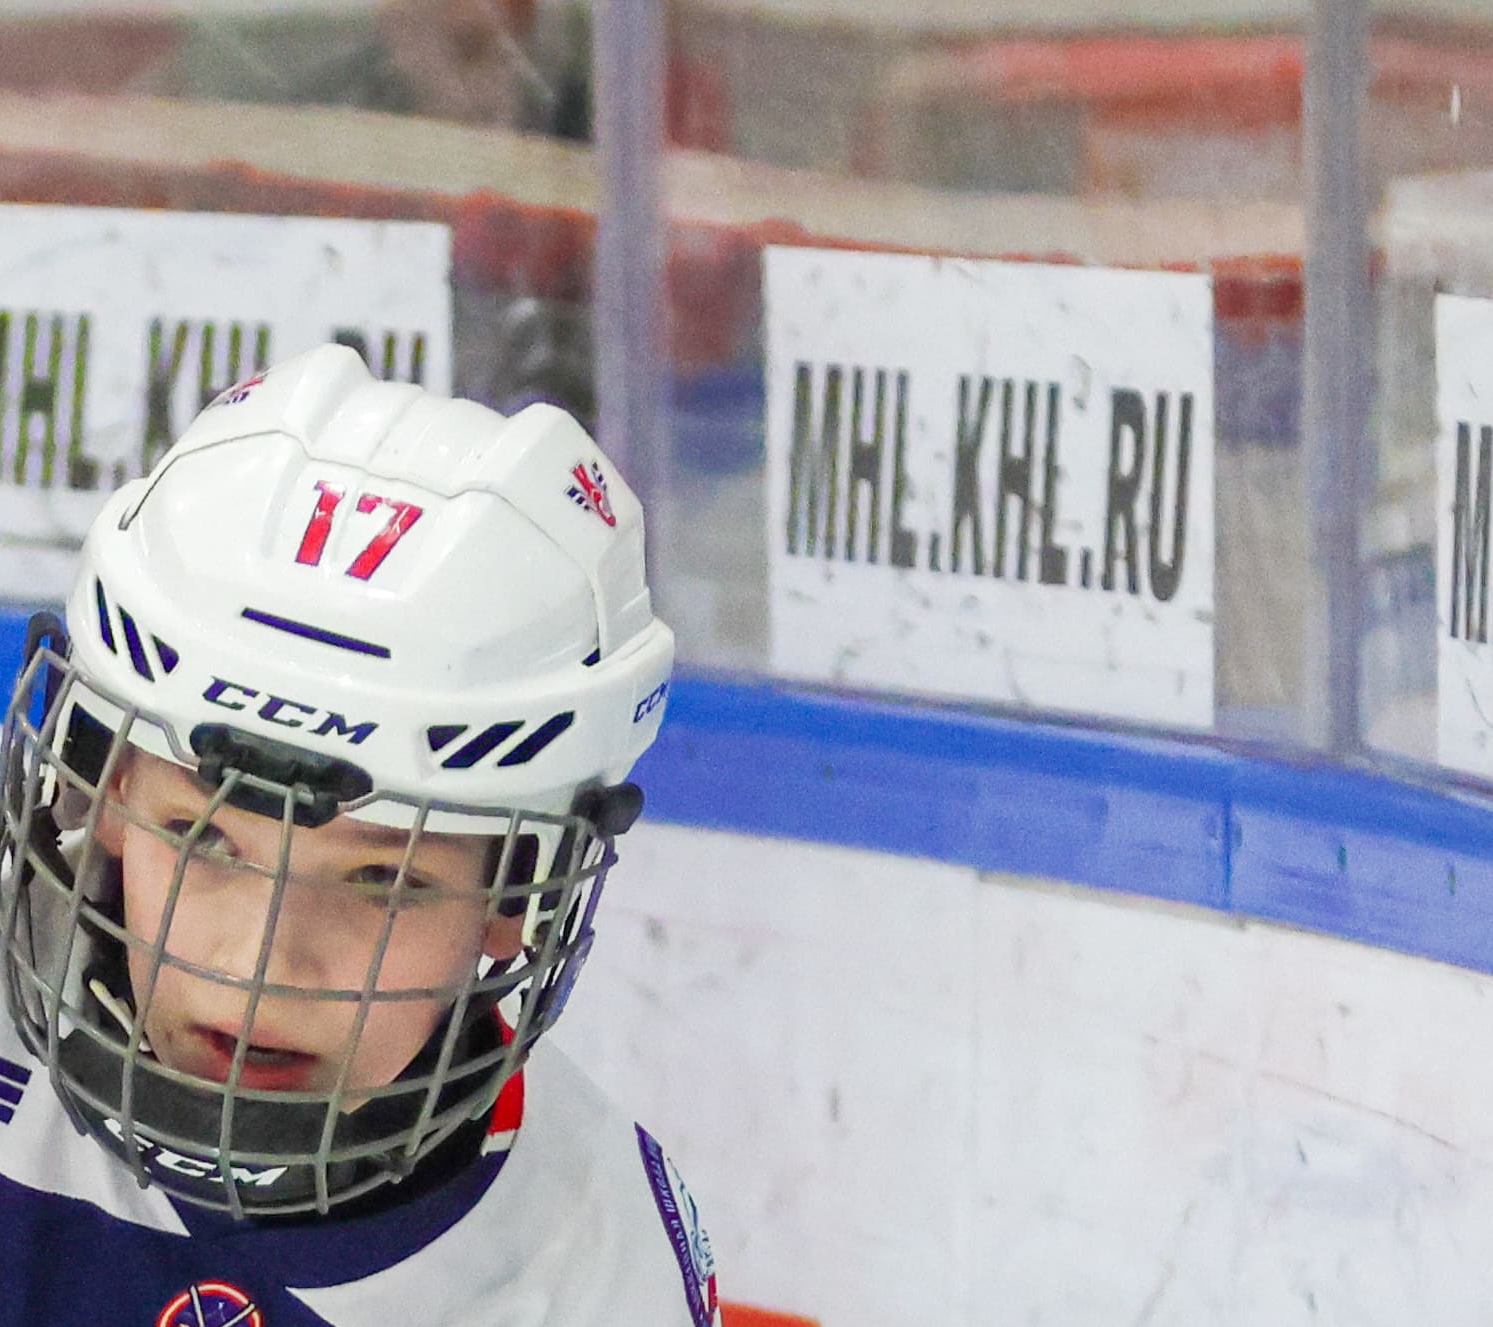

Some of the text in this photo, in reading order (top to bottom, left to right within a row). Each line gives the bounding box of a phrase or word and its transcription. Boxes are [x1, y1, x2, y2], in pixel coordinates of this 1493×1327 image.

[295, 480, 423, 581] 17
[785, 360, 1194, 602] MHL.KHL.RU
[202, 676, 379, 746] CCM
